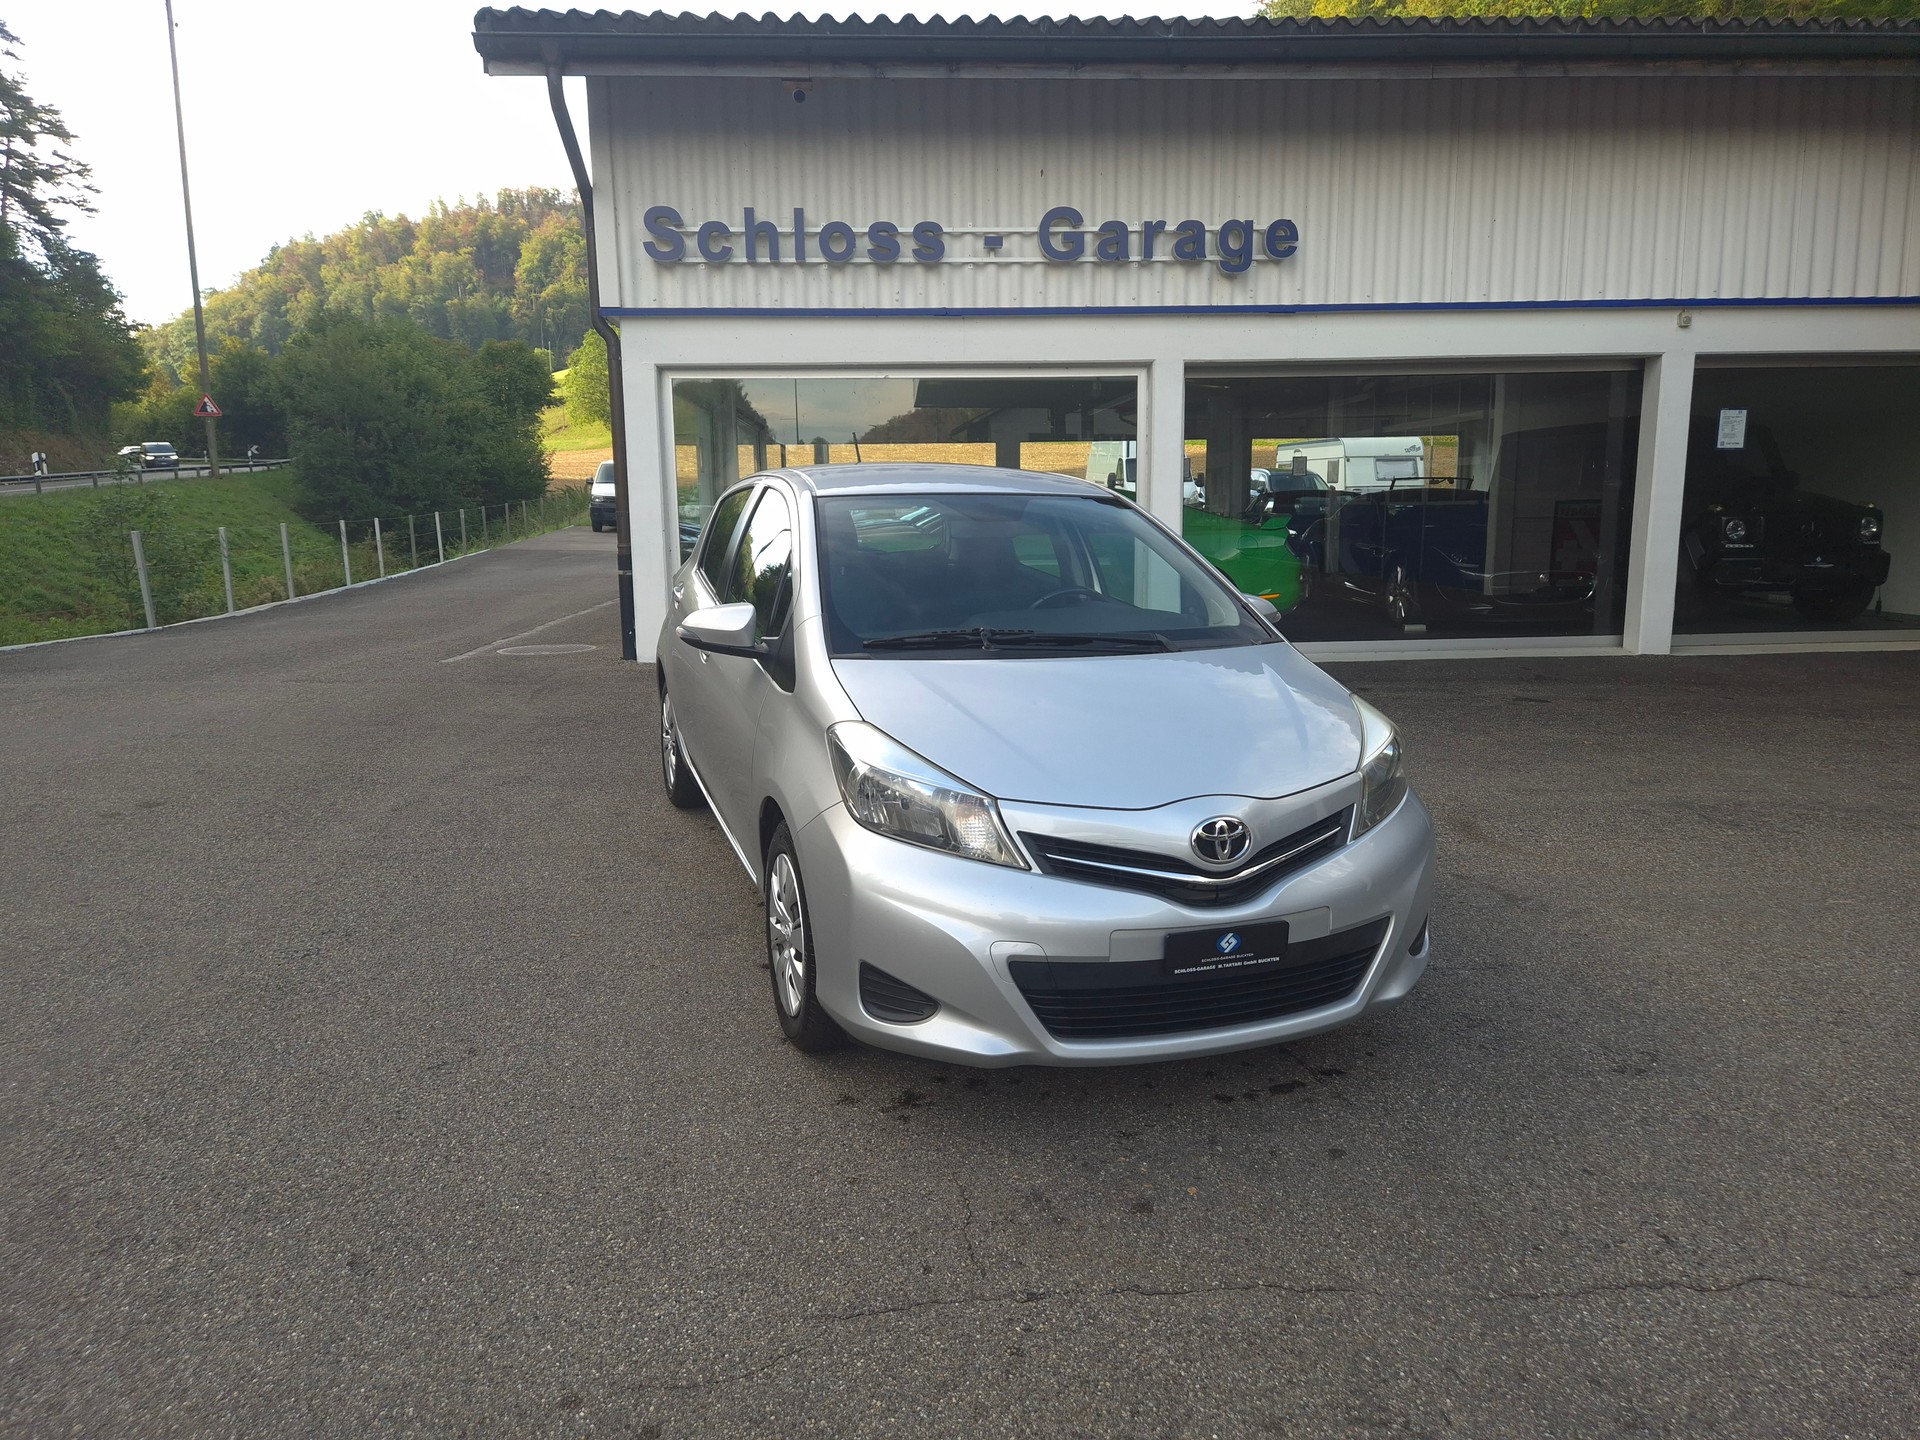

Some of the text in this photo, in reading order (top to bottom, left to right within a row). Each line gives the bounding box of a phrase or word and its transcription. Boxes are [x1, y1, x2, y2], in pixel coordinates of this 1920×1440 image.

[642, 205, 1300, 275] Schloss - Garage
[1174, 964, 1216, 975] SCHLOSS-GARAGE
[1258, 956, 1280, 964] BUCKTEN
